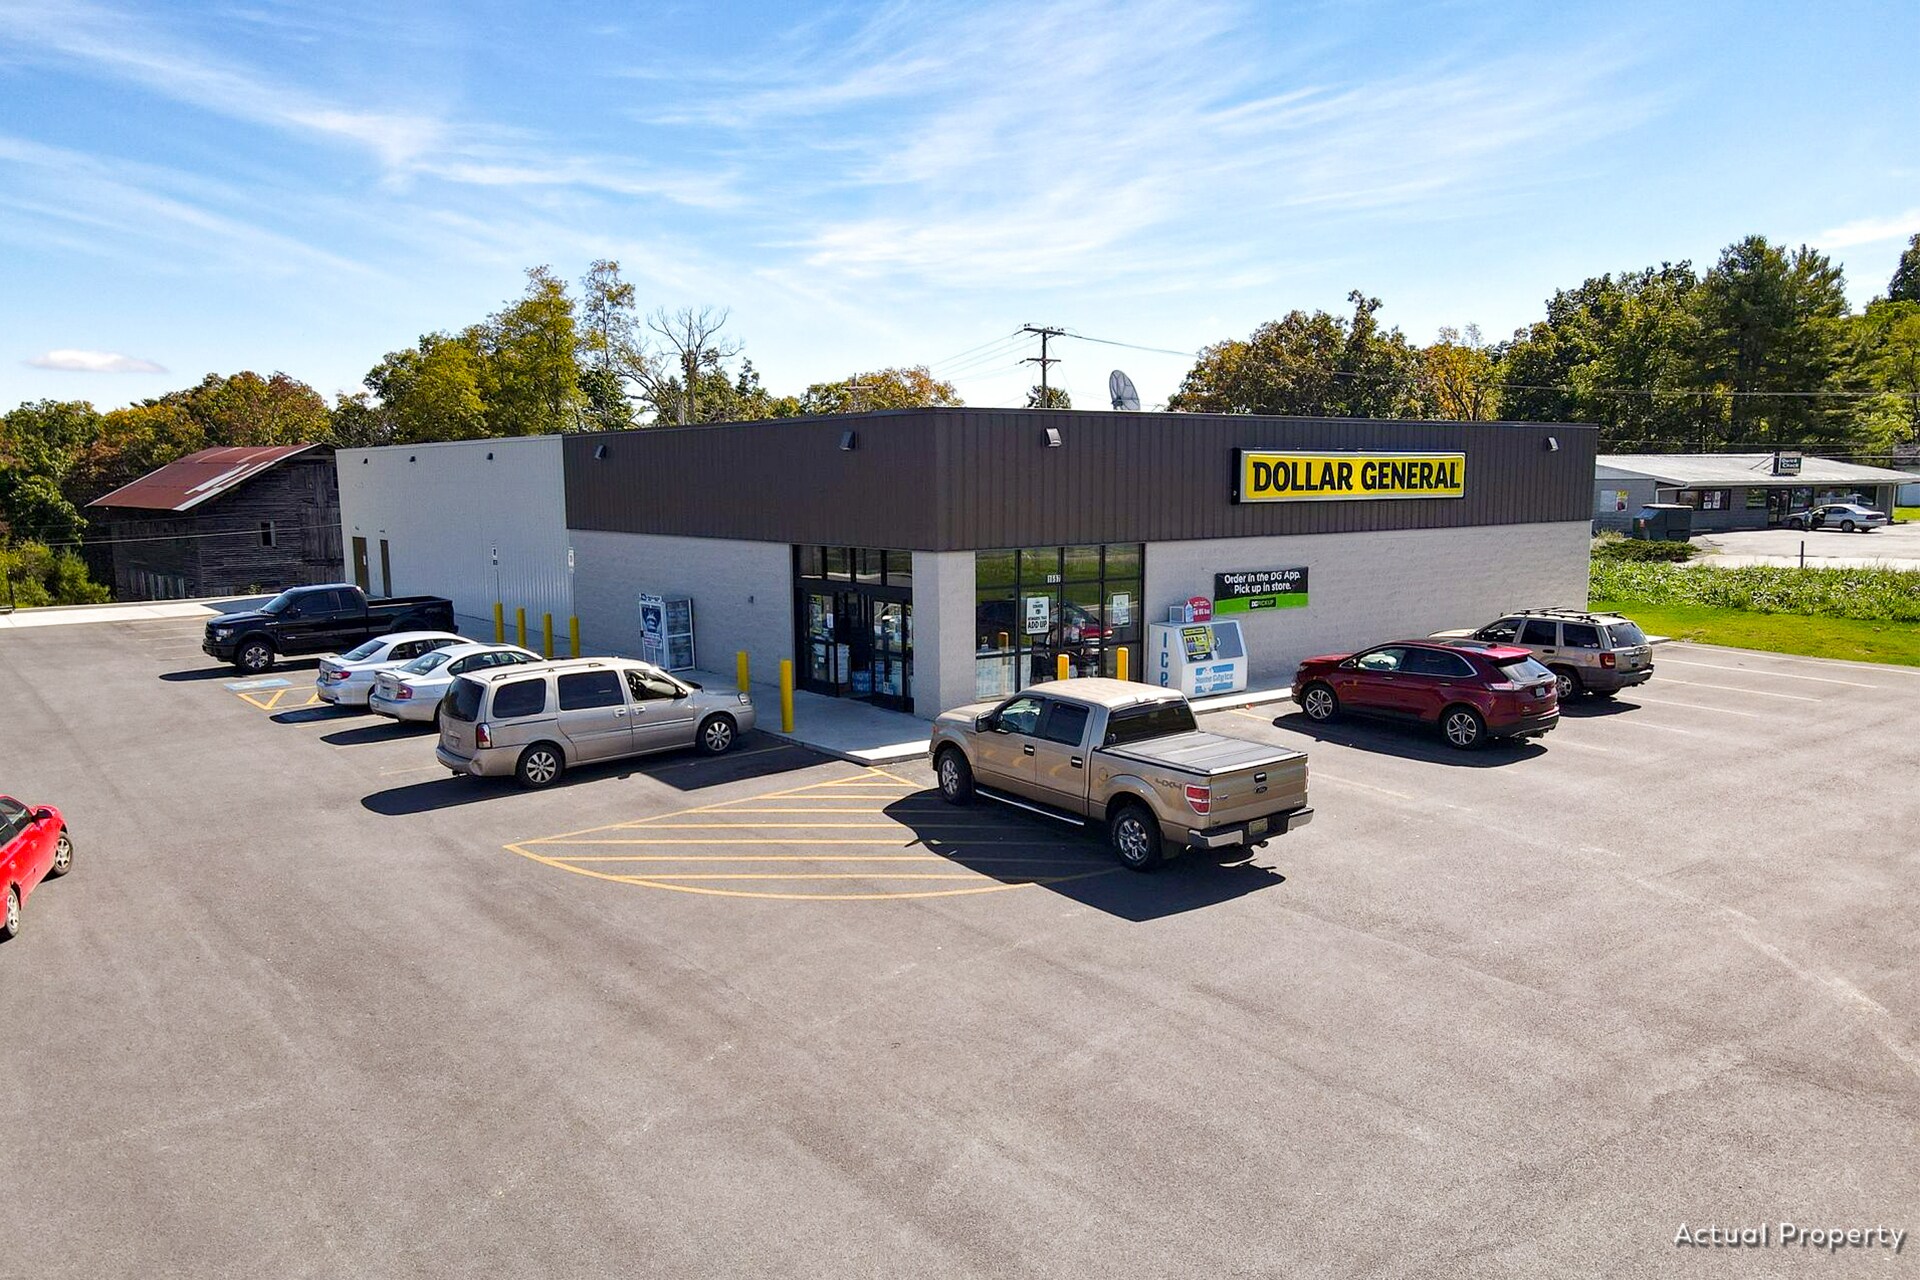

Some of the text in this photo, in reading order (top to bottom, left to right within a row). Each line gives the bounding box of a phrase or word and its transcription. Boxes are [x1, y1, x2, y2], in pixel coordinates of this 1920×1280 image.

[1252, 461, 1461, 492] DOLLAR GENERAL
[1224, 570, 1301, 584] Order in the DG App.
[1234, 582, 1291, 594] Pick up in store.
[1028, 620, 1047, 629] ADD UP
